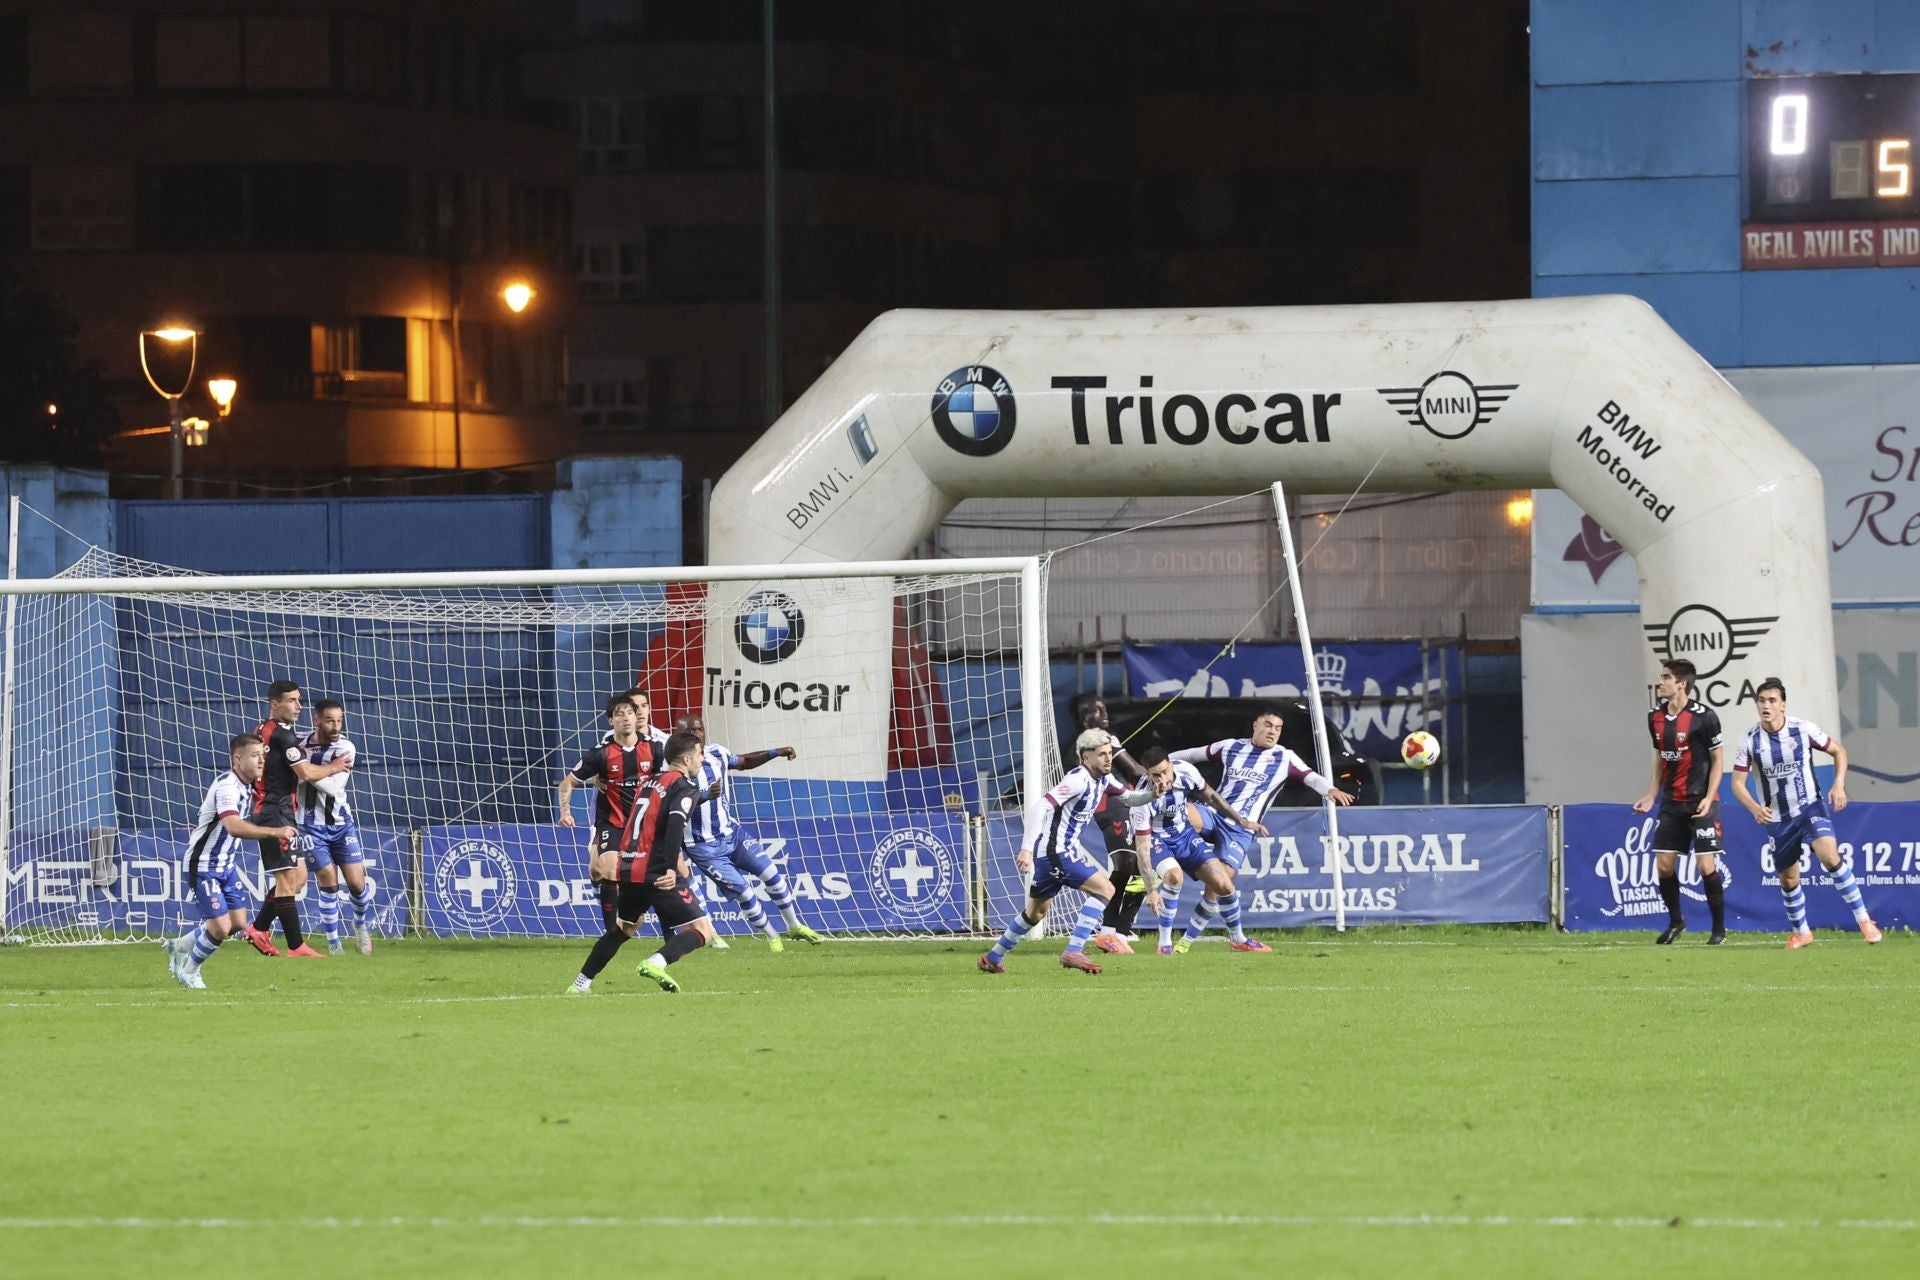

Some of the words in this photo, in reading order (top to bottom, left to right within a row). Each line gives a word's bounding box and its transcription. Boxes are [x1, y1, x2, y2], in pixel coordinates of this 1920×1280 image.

[1771, 94, 1808, 155] 0
[1878, 139, 1910, 196] 5
[1746, 231, 1797, 259] REAL
[1803, 229, 1874, 258] AVILES
[939, 367, 1011, 396] BMW
[1051, 375, 1342, 446] Triocar
[1425, 397, 1471, 415] MINI
[1597, 400, 1662, 460] BMW
[1576, 425, 1676, 523] Motorrad
[786, 474, 840, 530] BMW
[1674, 631, 1723, 653] MINI
[706, 667, 850, 712] Triocar
[633, 798, 650, 840] 7
[602, 830, 609, 840] 5
[894, 832, 914, 843] DE
[872, 839, 894, 878] CRUZ
[915, 832, 951, 898] ASTURIAS
[1320, 833, 1480, 874] RURAL
[1862, 842, 1892, 872] 12
[202, 878, 221, 896] 14
[437, 849, 460, 888] CRUZ
[459, 842, 479, 854] DE
[480, 844, 516, 909] ASTURIAS
[874, 879, 888, 899] LA
[1894, 875, 1904, 885] de
[538, 879, 602, 907] DE
[1249, 887, 1397, 914] ASTURIAS
[1621, 887, 1657, 902] TASCA
